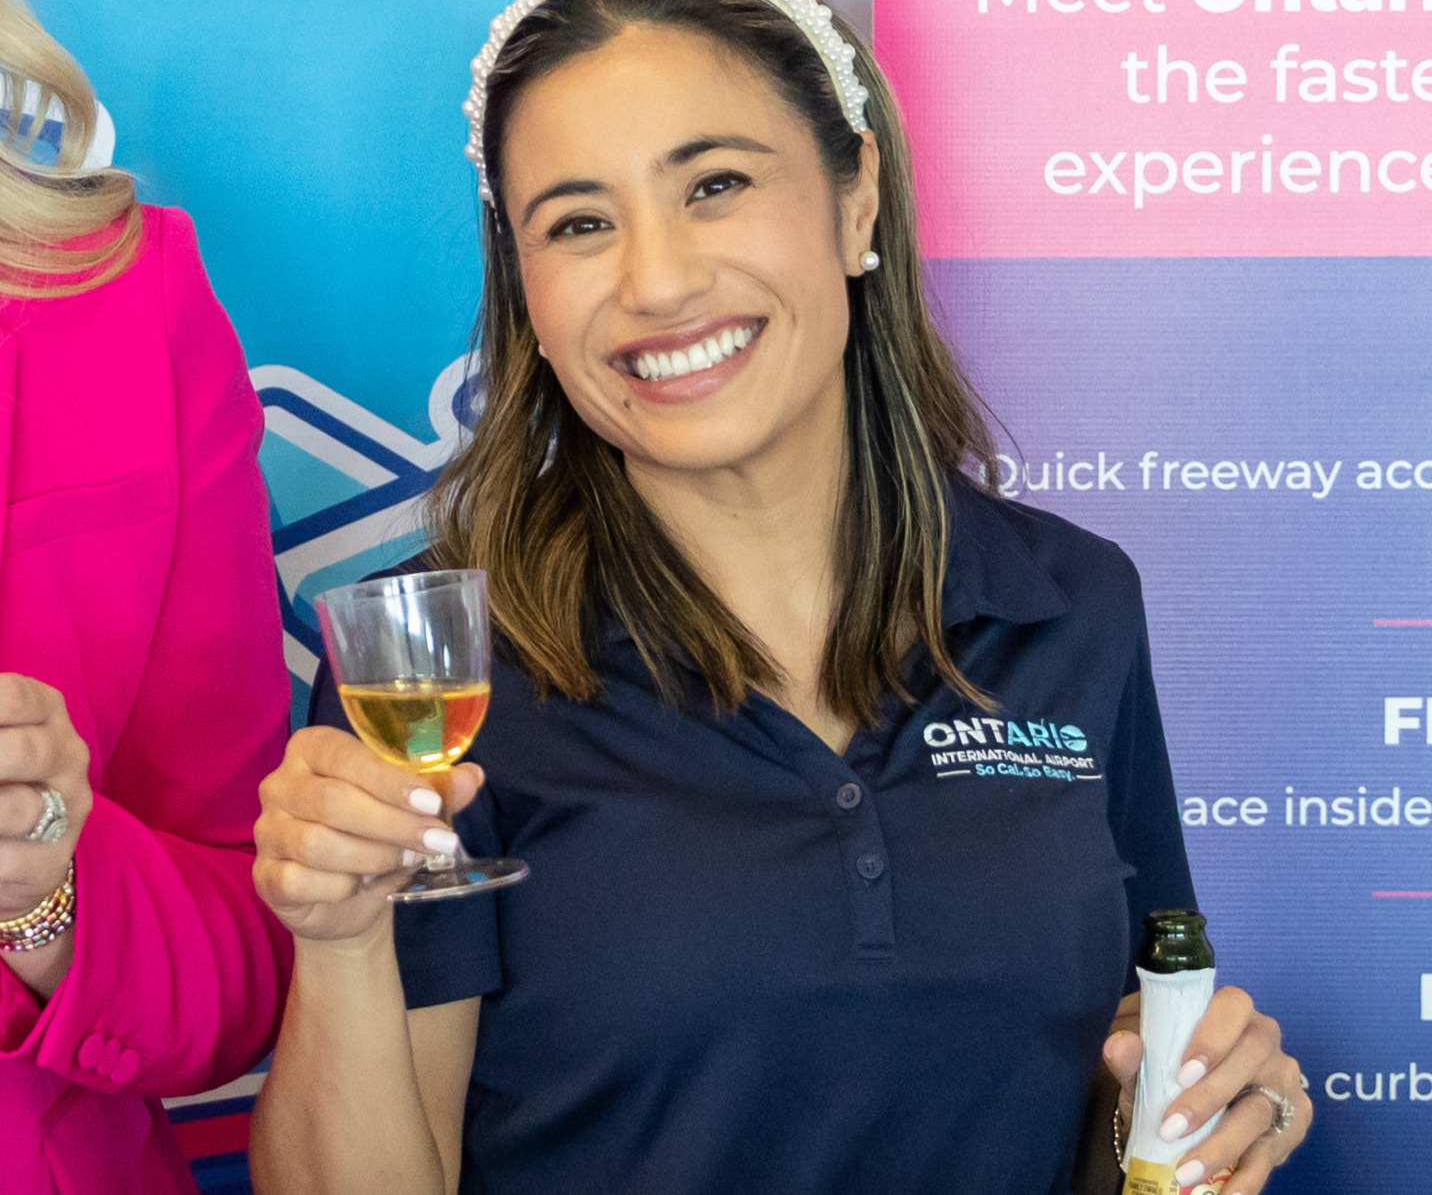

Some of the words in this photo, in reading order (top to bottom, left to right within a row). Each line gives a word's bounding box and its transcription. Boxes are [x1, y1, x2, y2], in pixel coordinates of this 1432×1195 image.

[1122, 45, 1246, 102] the
[979, 452, 1125, 498] Quick
[1139, 451, 1342, 500] freeway
[923, 717, 1088, 752] ONTARIO
[931, 749, 1042, 766] INTERNATIONAL
[1044, 754, 1094, 769] AIRPORT
[975, 763, 995, 776] So
[1182, 796, 1268, 826] ace
[1285, 785, 1432, 826] inside
